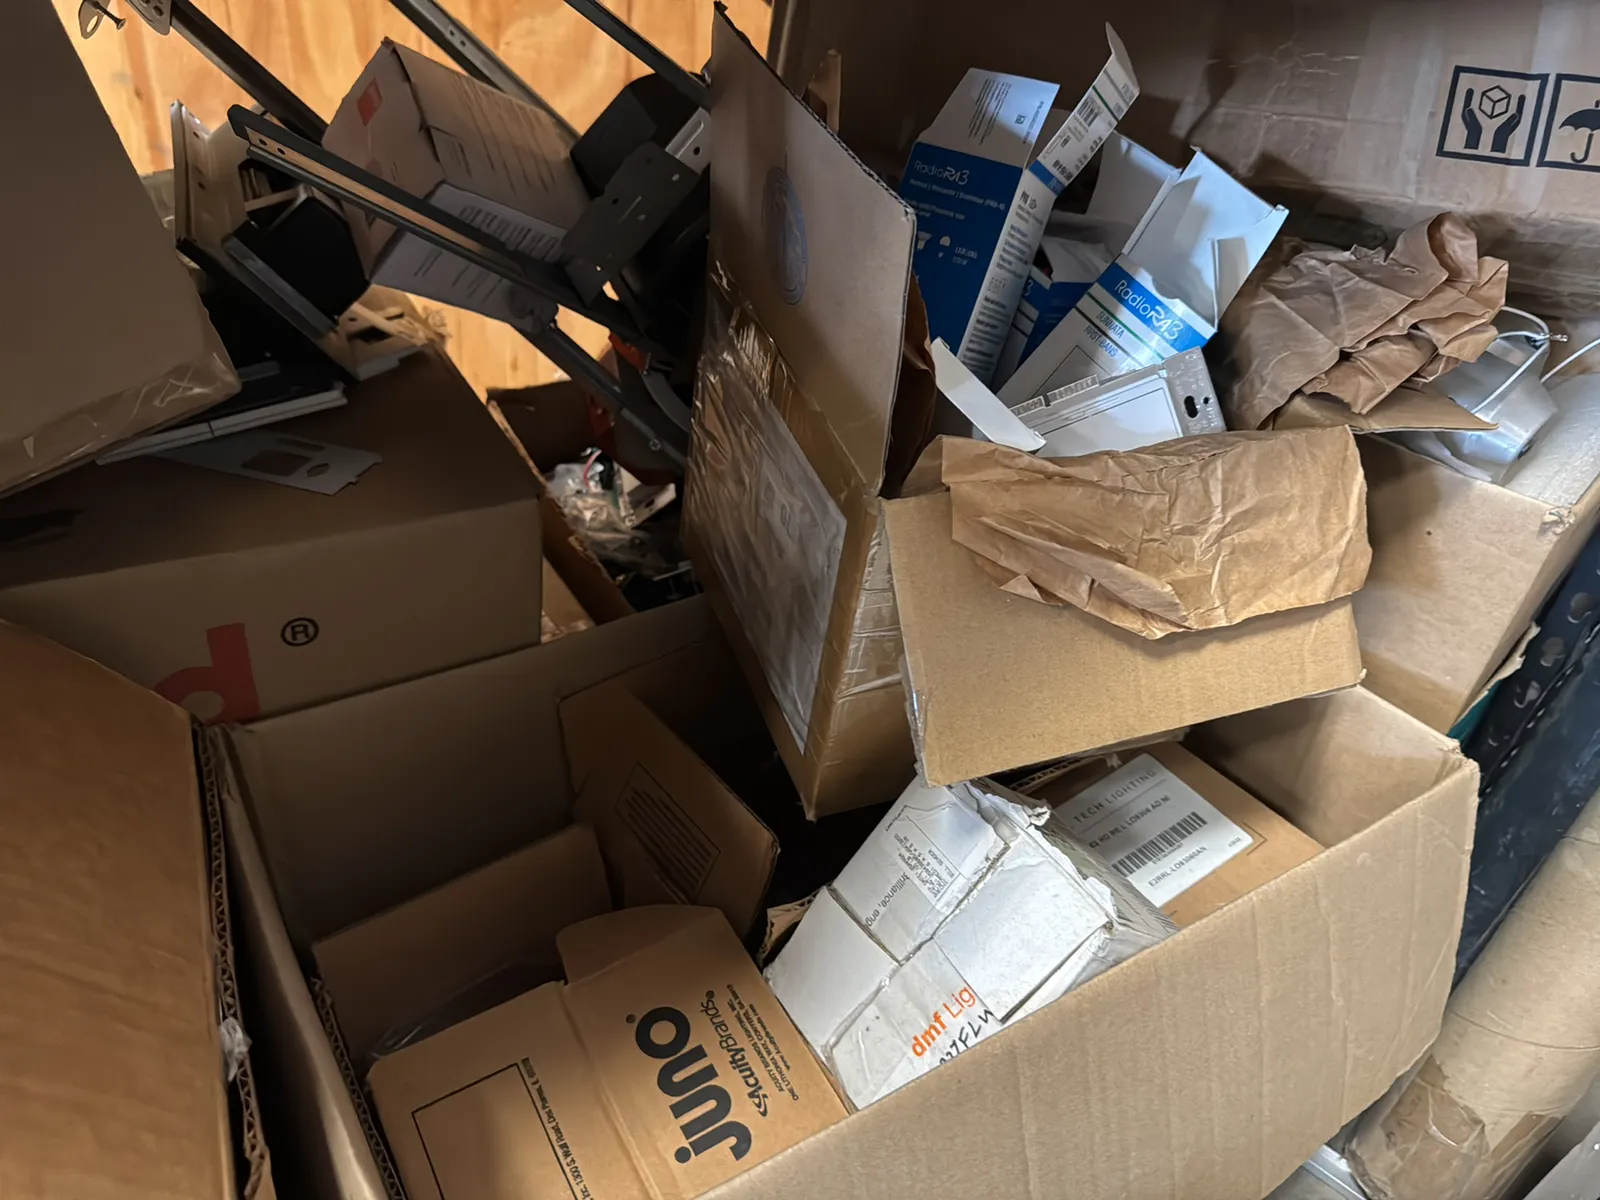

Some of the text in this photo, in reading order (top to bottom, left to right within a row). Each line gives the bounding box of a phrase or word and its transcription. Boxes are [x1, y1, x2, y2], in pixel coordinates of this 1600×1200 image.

[1073, 802, 1104, 824] TECH
[911, 986, 977, 1057] dmf Lig
[634, 1005, 753, 1165] juno
[766, 1068, 785, 1092] ACUITY
